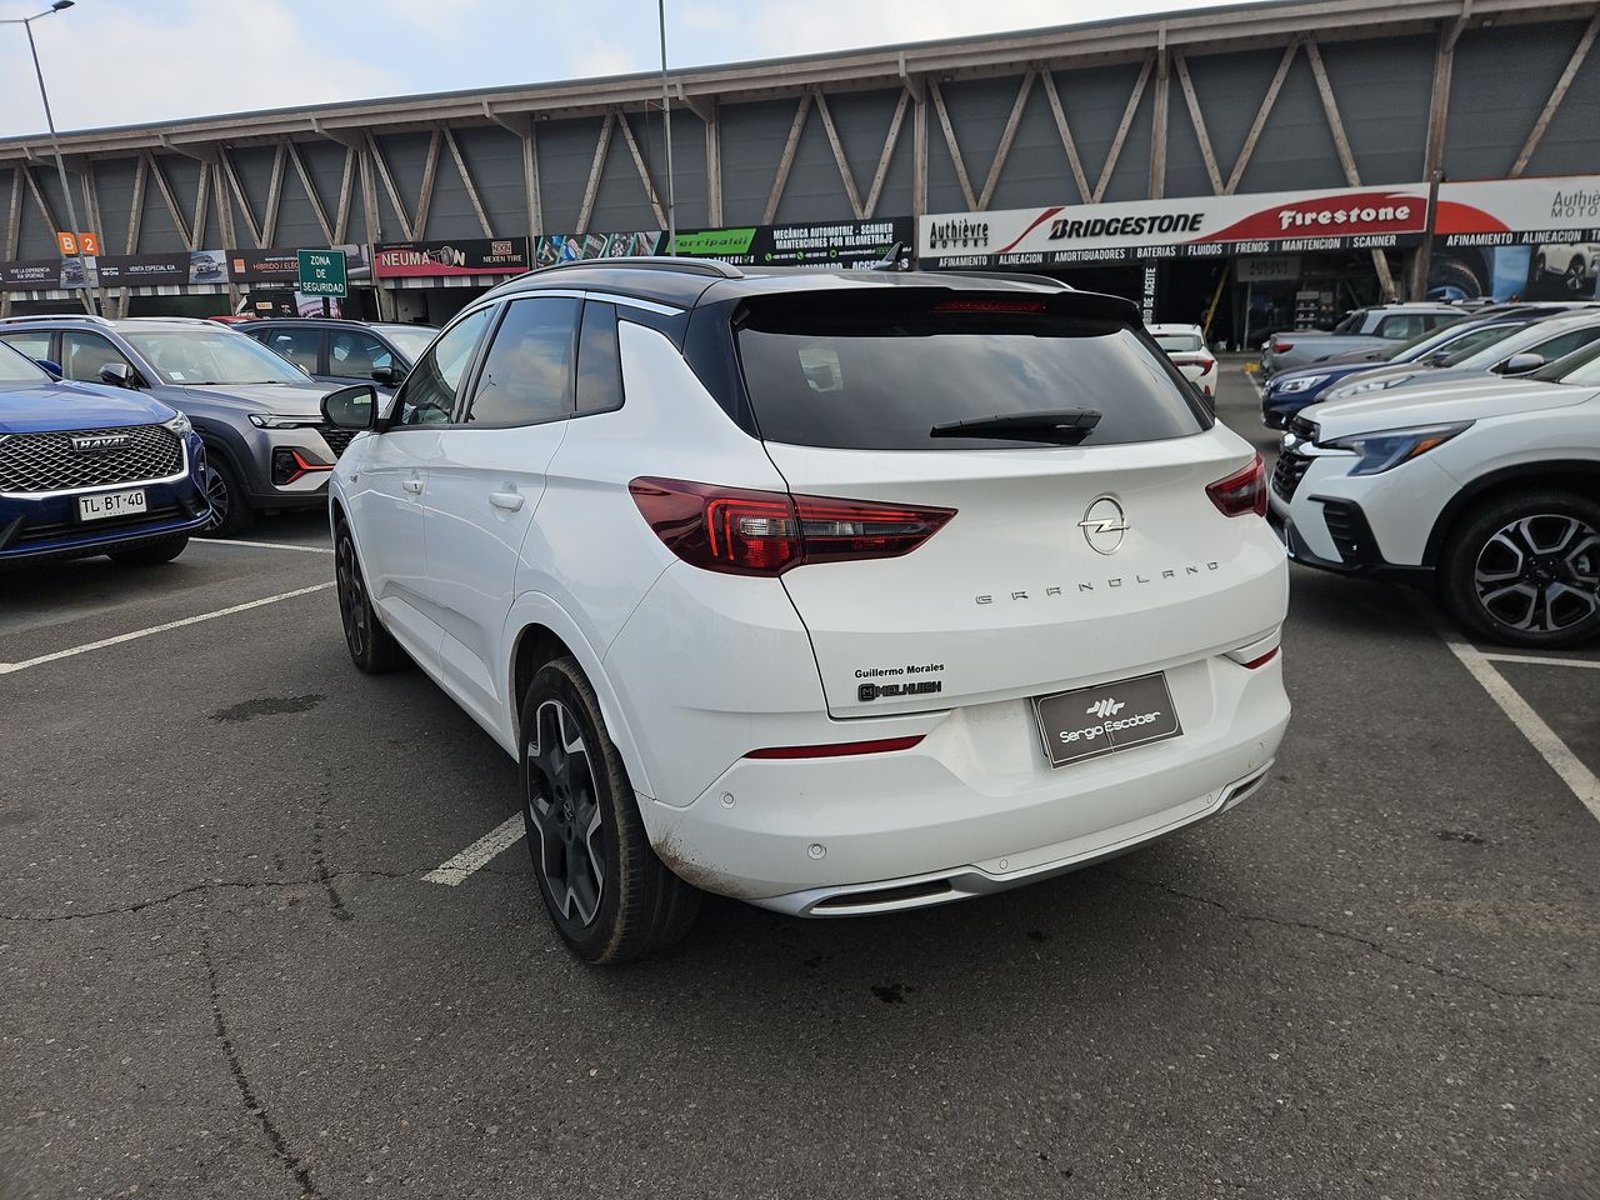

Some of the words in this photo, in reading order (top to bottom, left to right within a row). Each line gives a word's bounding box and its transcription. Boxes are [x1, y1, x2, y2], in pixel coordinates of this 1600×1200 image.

[1278, 205, 1411, 231] Firestone
[810, 226, 854, 238] AUTOMOTRIZ
[861, 223, 894, 235] SCANNER
[930, 218, 989, 240] Authièvre
[1048, 213, 1205, 240] BRIDGESTONE
[64, 237, 74, 251] B
[85, 238, 94, 251] 2
[776, 238, 828, 249] MANTENCIONES
[829, 236, 843, 247] POR
[845, 233, 893, 246] KILOMETRAJE
[930, 238, 988, 249] MOTORS
[1446, 232, 1513, 247] AFINAMIENTO
[1522, 230, 1582, 244] ALINEACION
[938, 256, 988, 268] AFINAMIENTO
[999, 253, 1043, 265] ALINEACION
[1054, 249, 1126, 263] AMORTIGUADORES
[1136, 245, 1176, 258] BATERIAS
[1188, 243, 1223, 256] FLUIDOS
[1235, 242, 1270, 254] FRENOS
[1281, 238, 1341, 251] MANTENCION
[1353, 235, 1397, 248] SCANNER
[310, 255, 331, 266] ZONA
[315, 269, 327, 278] DE
[1144, 267, 1156, 296] ACEITE
[302, 283, 344, 293] SEGURIDAD
[80, 438, 127, 449] HAVAL
[975, 561, 1219, 605] GRANDLAND
[855, 668, 904, 678] Guillermo
[906, 663, 945, 674] Morales
[1104, 711, 1161, 732] Escobar
